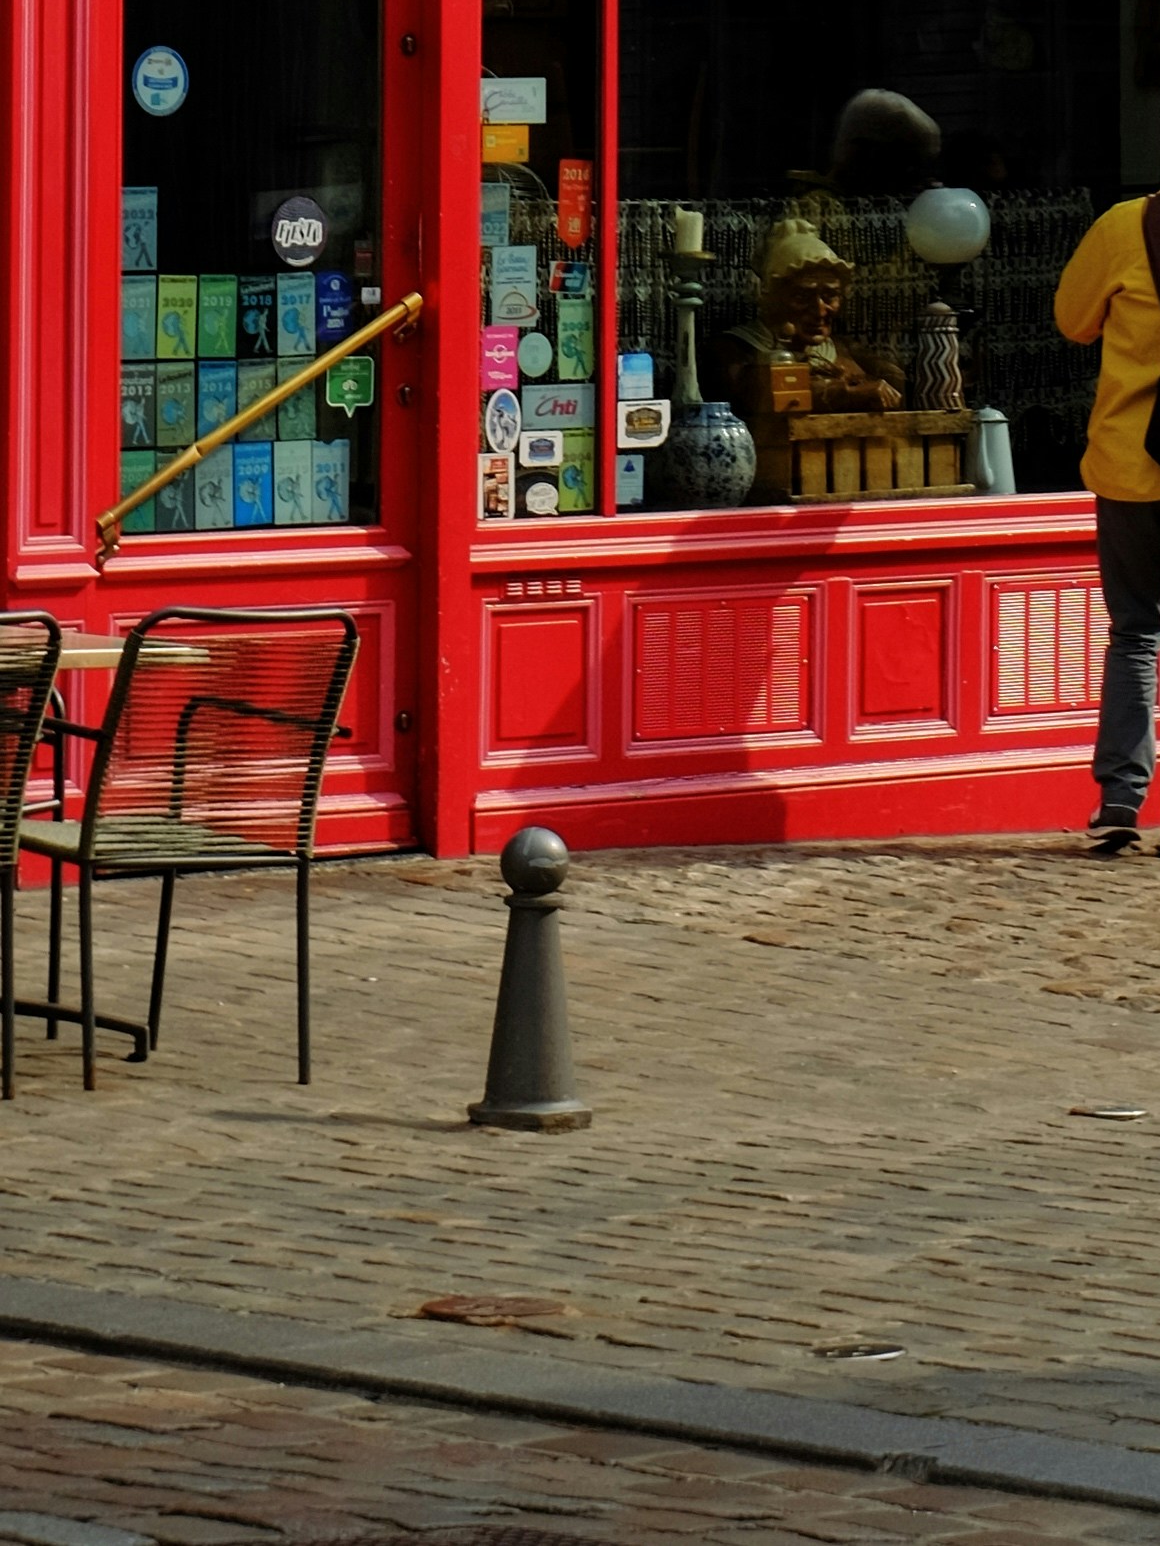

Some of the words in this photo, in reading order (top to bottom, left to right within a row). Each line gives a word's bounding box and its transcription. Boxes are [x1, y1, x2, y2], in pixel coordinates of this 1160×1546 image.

[203, 296, 233, 307] 2019
[242, 294, 273, 305] 2018
[281, 294, 312, 305] 2017
[158, 383, 191, 394] 2013
[203, 382, 233, 392] 2014
[243, 379, 272, 390] 2015
[121, 385, 153, 396] 2012
[238, 464, 269, 475] 2009
